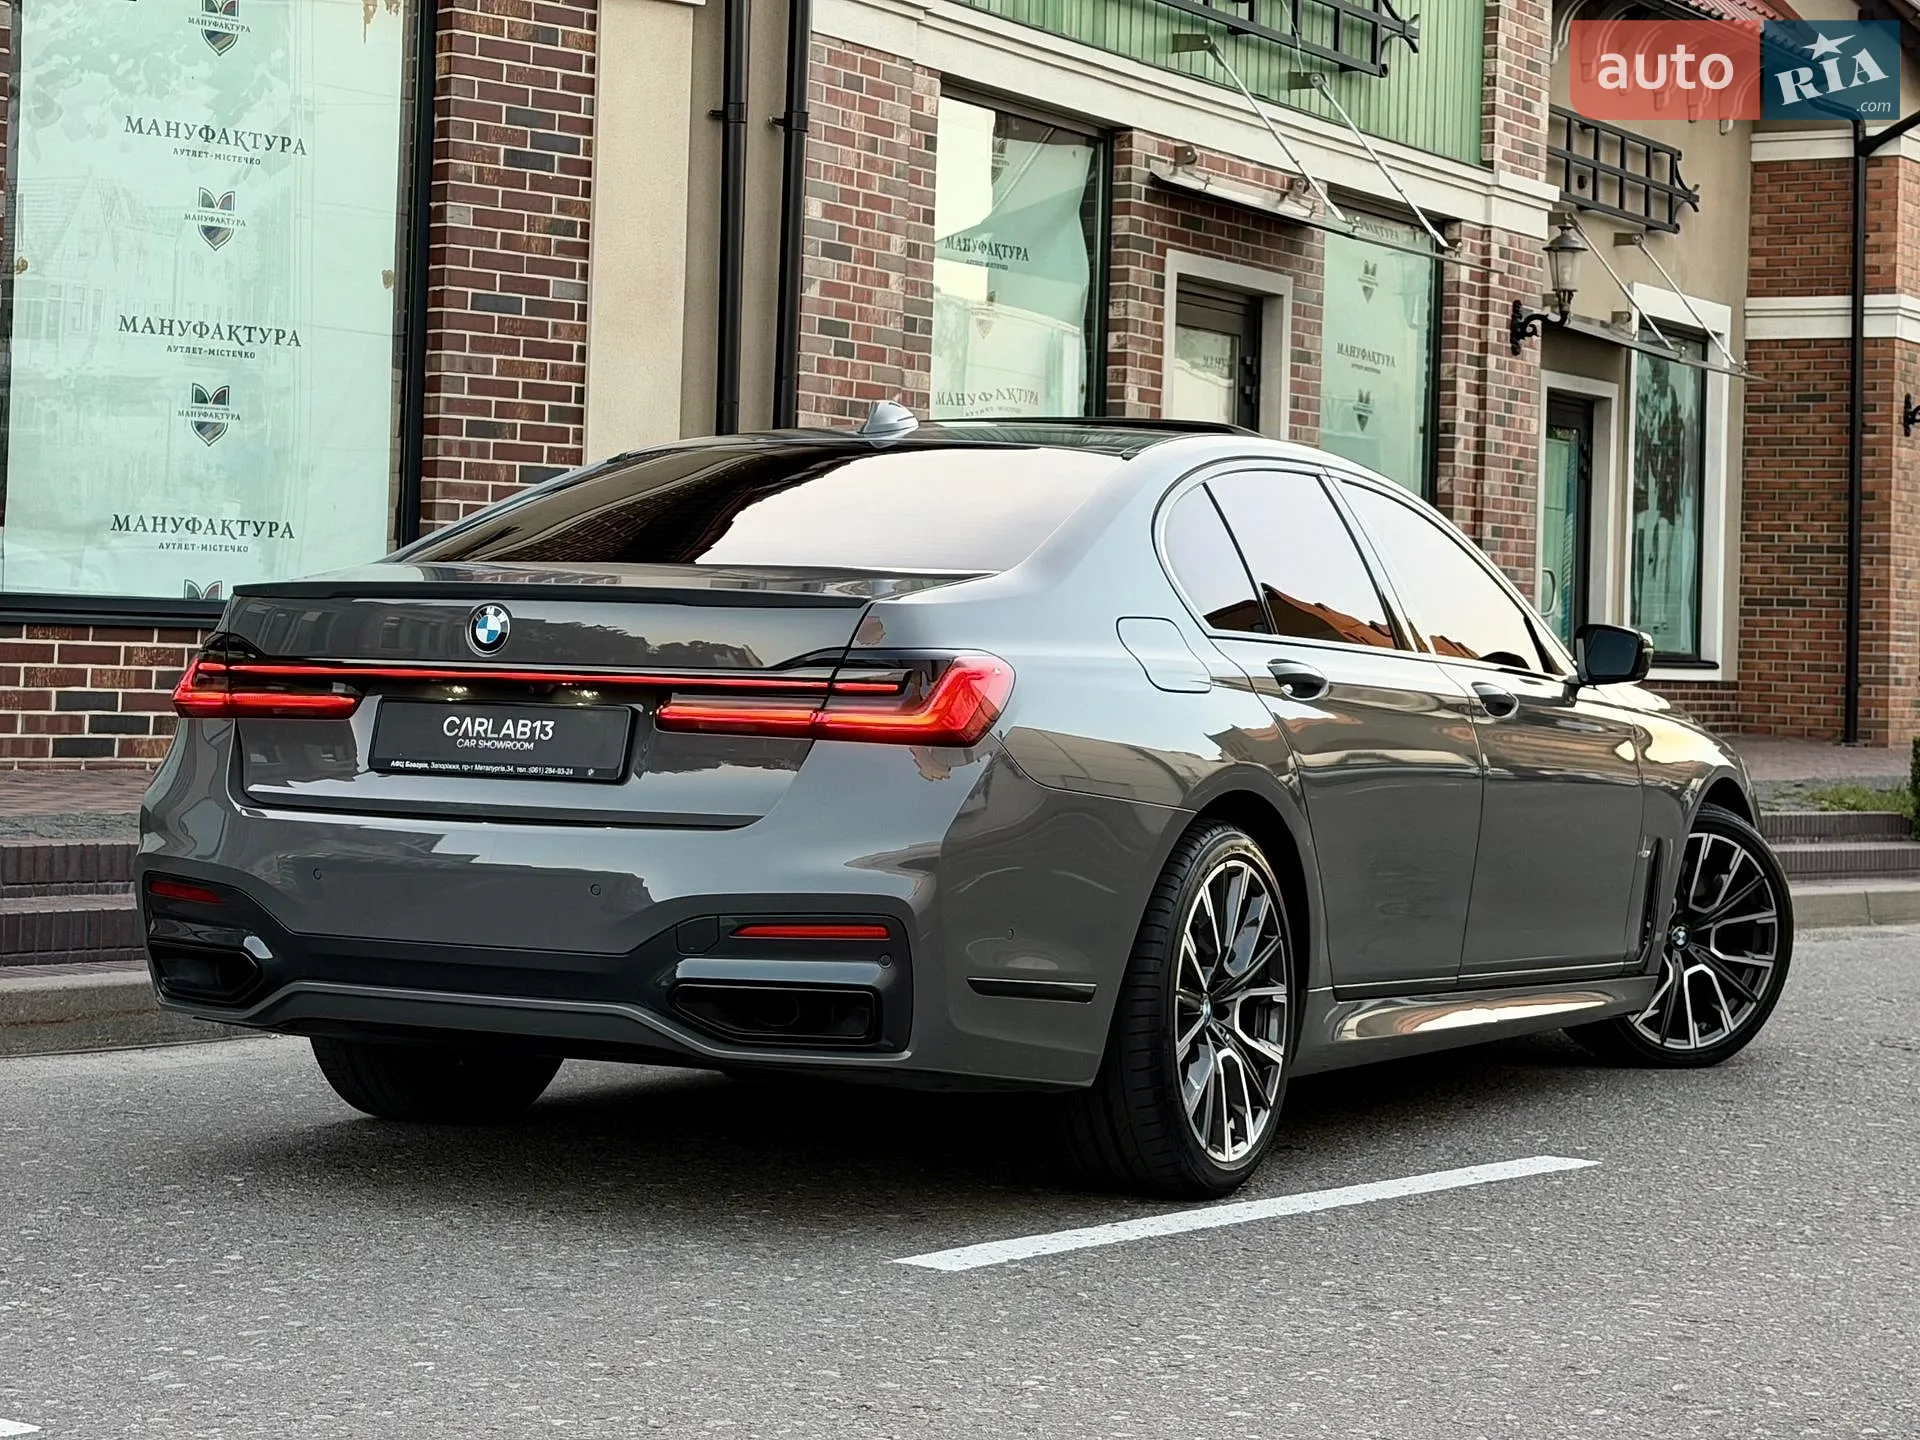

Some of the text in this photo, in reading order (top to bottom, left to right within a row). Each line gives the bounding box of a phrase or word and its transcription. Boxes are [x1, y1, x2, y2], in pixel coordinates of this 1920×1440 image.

[187, 17, 251, 33] МАНУФАКТУРА
[124, 116, 308, 156] МАНУФАКТУРА
[172, 147, 262, 166] АУТЛЕТ-МІСТЕЧКО
[184, 212, 247, 228] МАНУФАКТУРА
[944, 236, 1030, 262] МАНУФАКТУРА
[118, 314, 302, 348] МАНУФАКТУРА
[166, 344, 256, 359] АУТЛЕТ-МІСТЕЧКО
[935, 387, 1039, 406] МАНУФАКТУРА
[177, 409, 241, 421] МАНУФАКТУРА
[110, 513, 295, 541] МАНУФАКТУРА
[158, 541, 249, 554] АУТЛЕТ-МІСТЕЧКО
[443, 716, 555, 741] CARLAB13
[456, 738, 534, 751] CAR SHOWROOM
